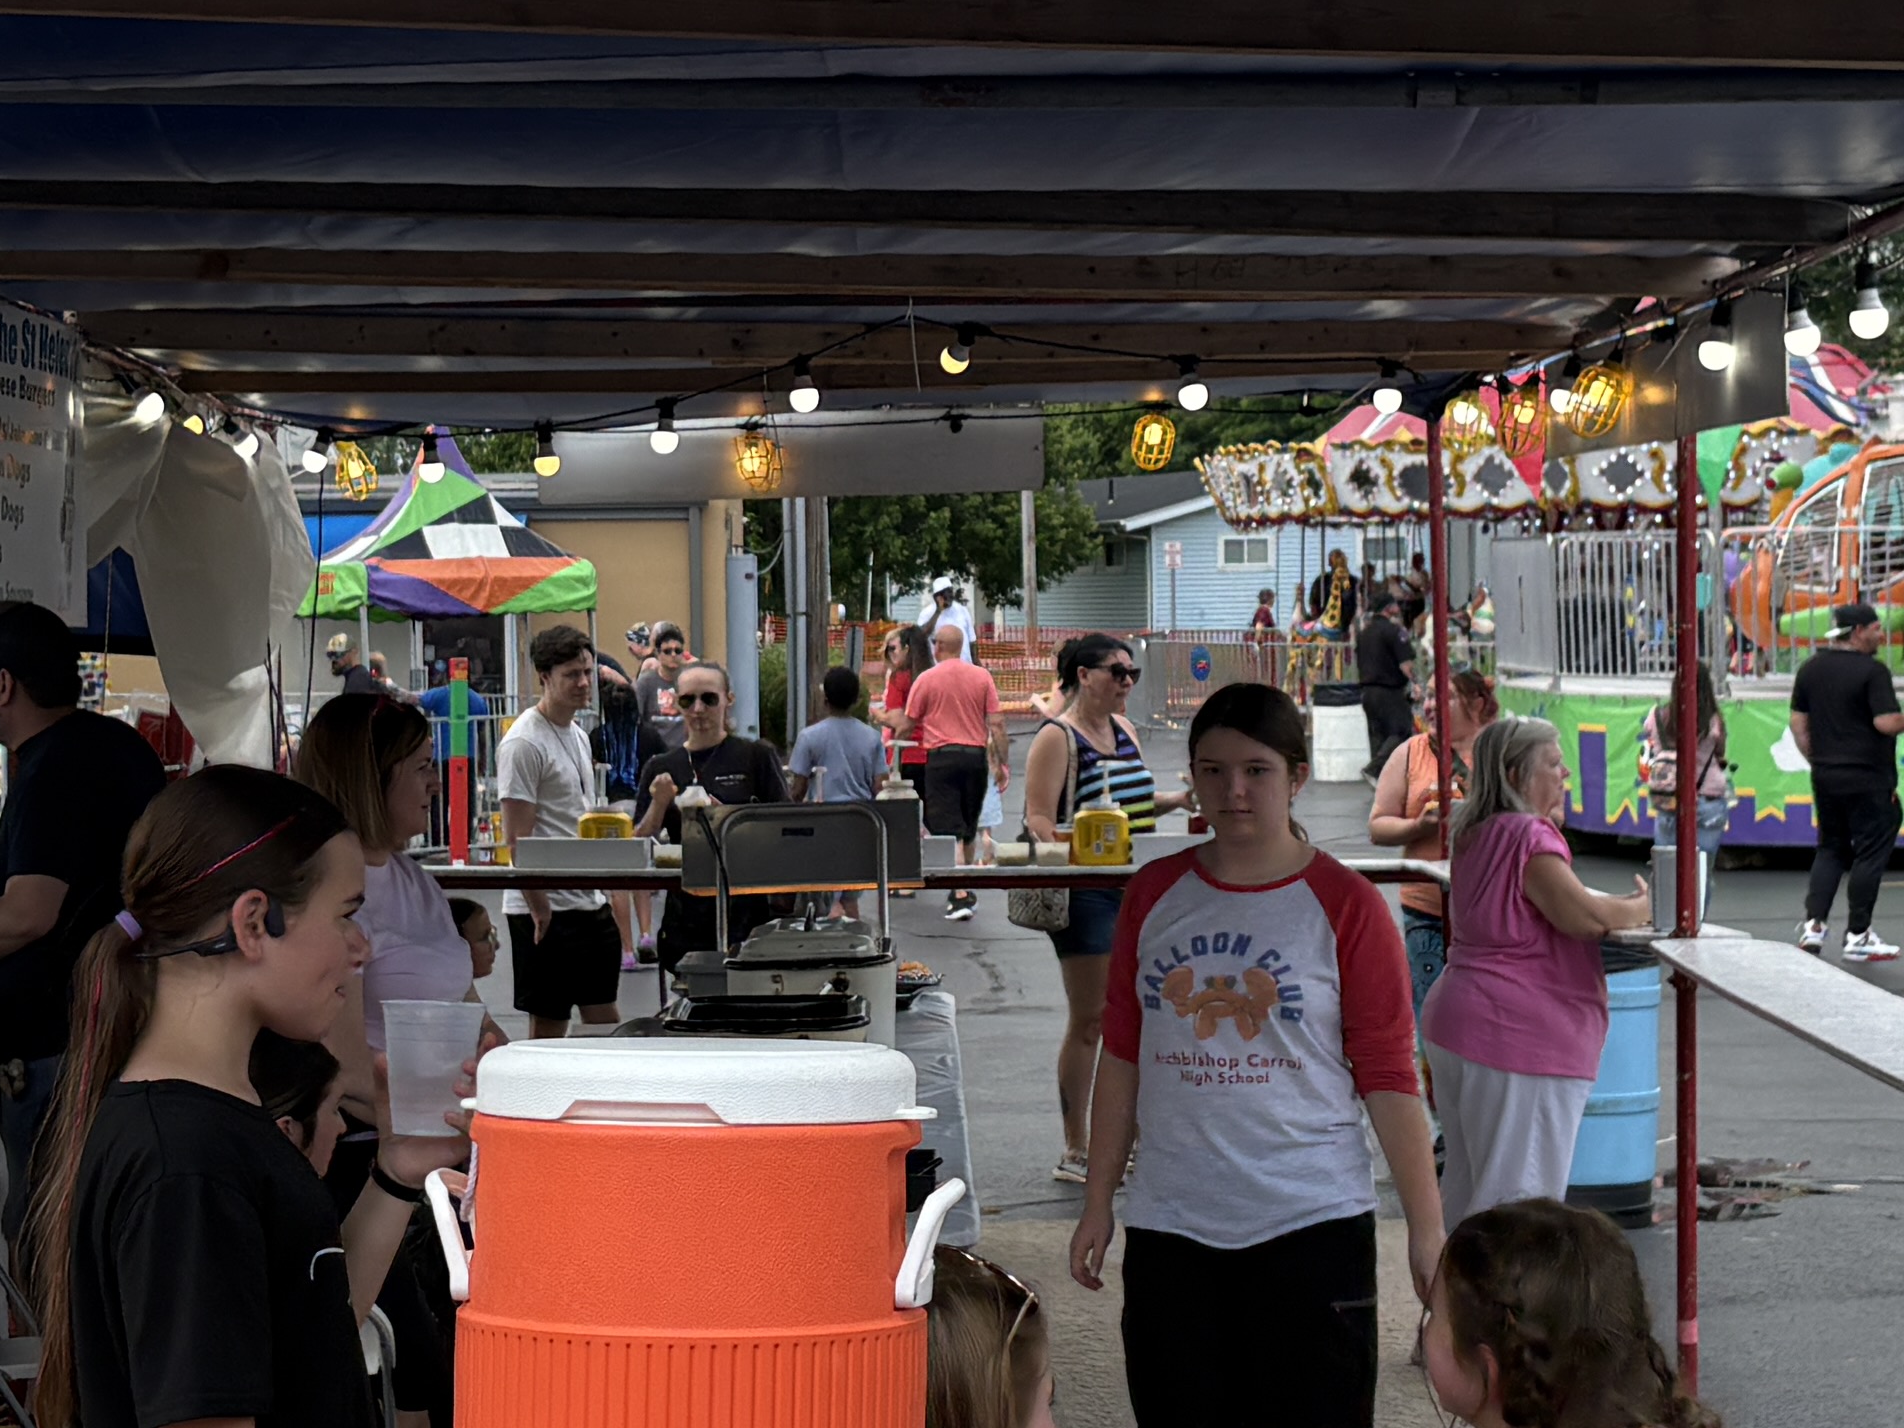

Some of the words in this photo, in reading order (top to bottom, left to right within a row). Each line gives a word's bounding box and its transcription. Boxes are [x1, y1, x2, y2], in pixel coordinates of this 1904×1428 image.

[22, 317, 37, 370] St
[0, 494, 25, 531] Dogs
[1143, 931, 1253, 1011] BALLOON
[1256, 948, 1304, 1023] CLUB
[1180, 1069, 1213, 1086] High
[1217, 1070, 1271, 1085] School
